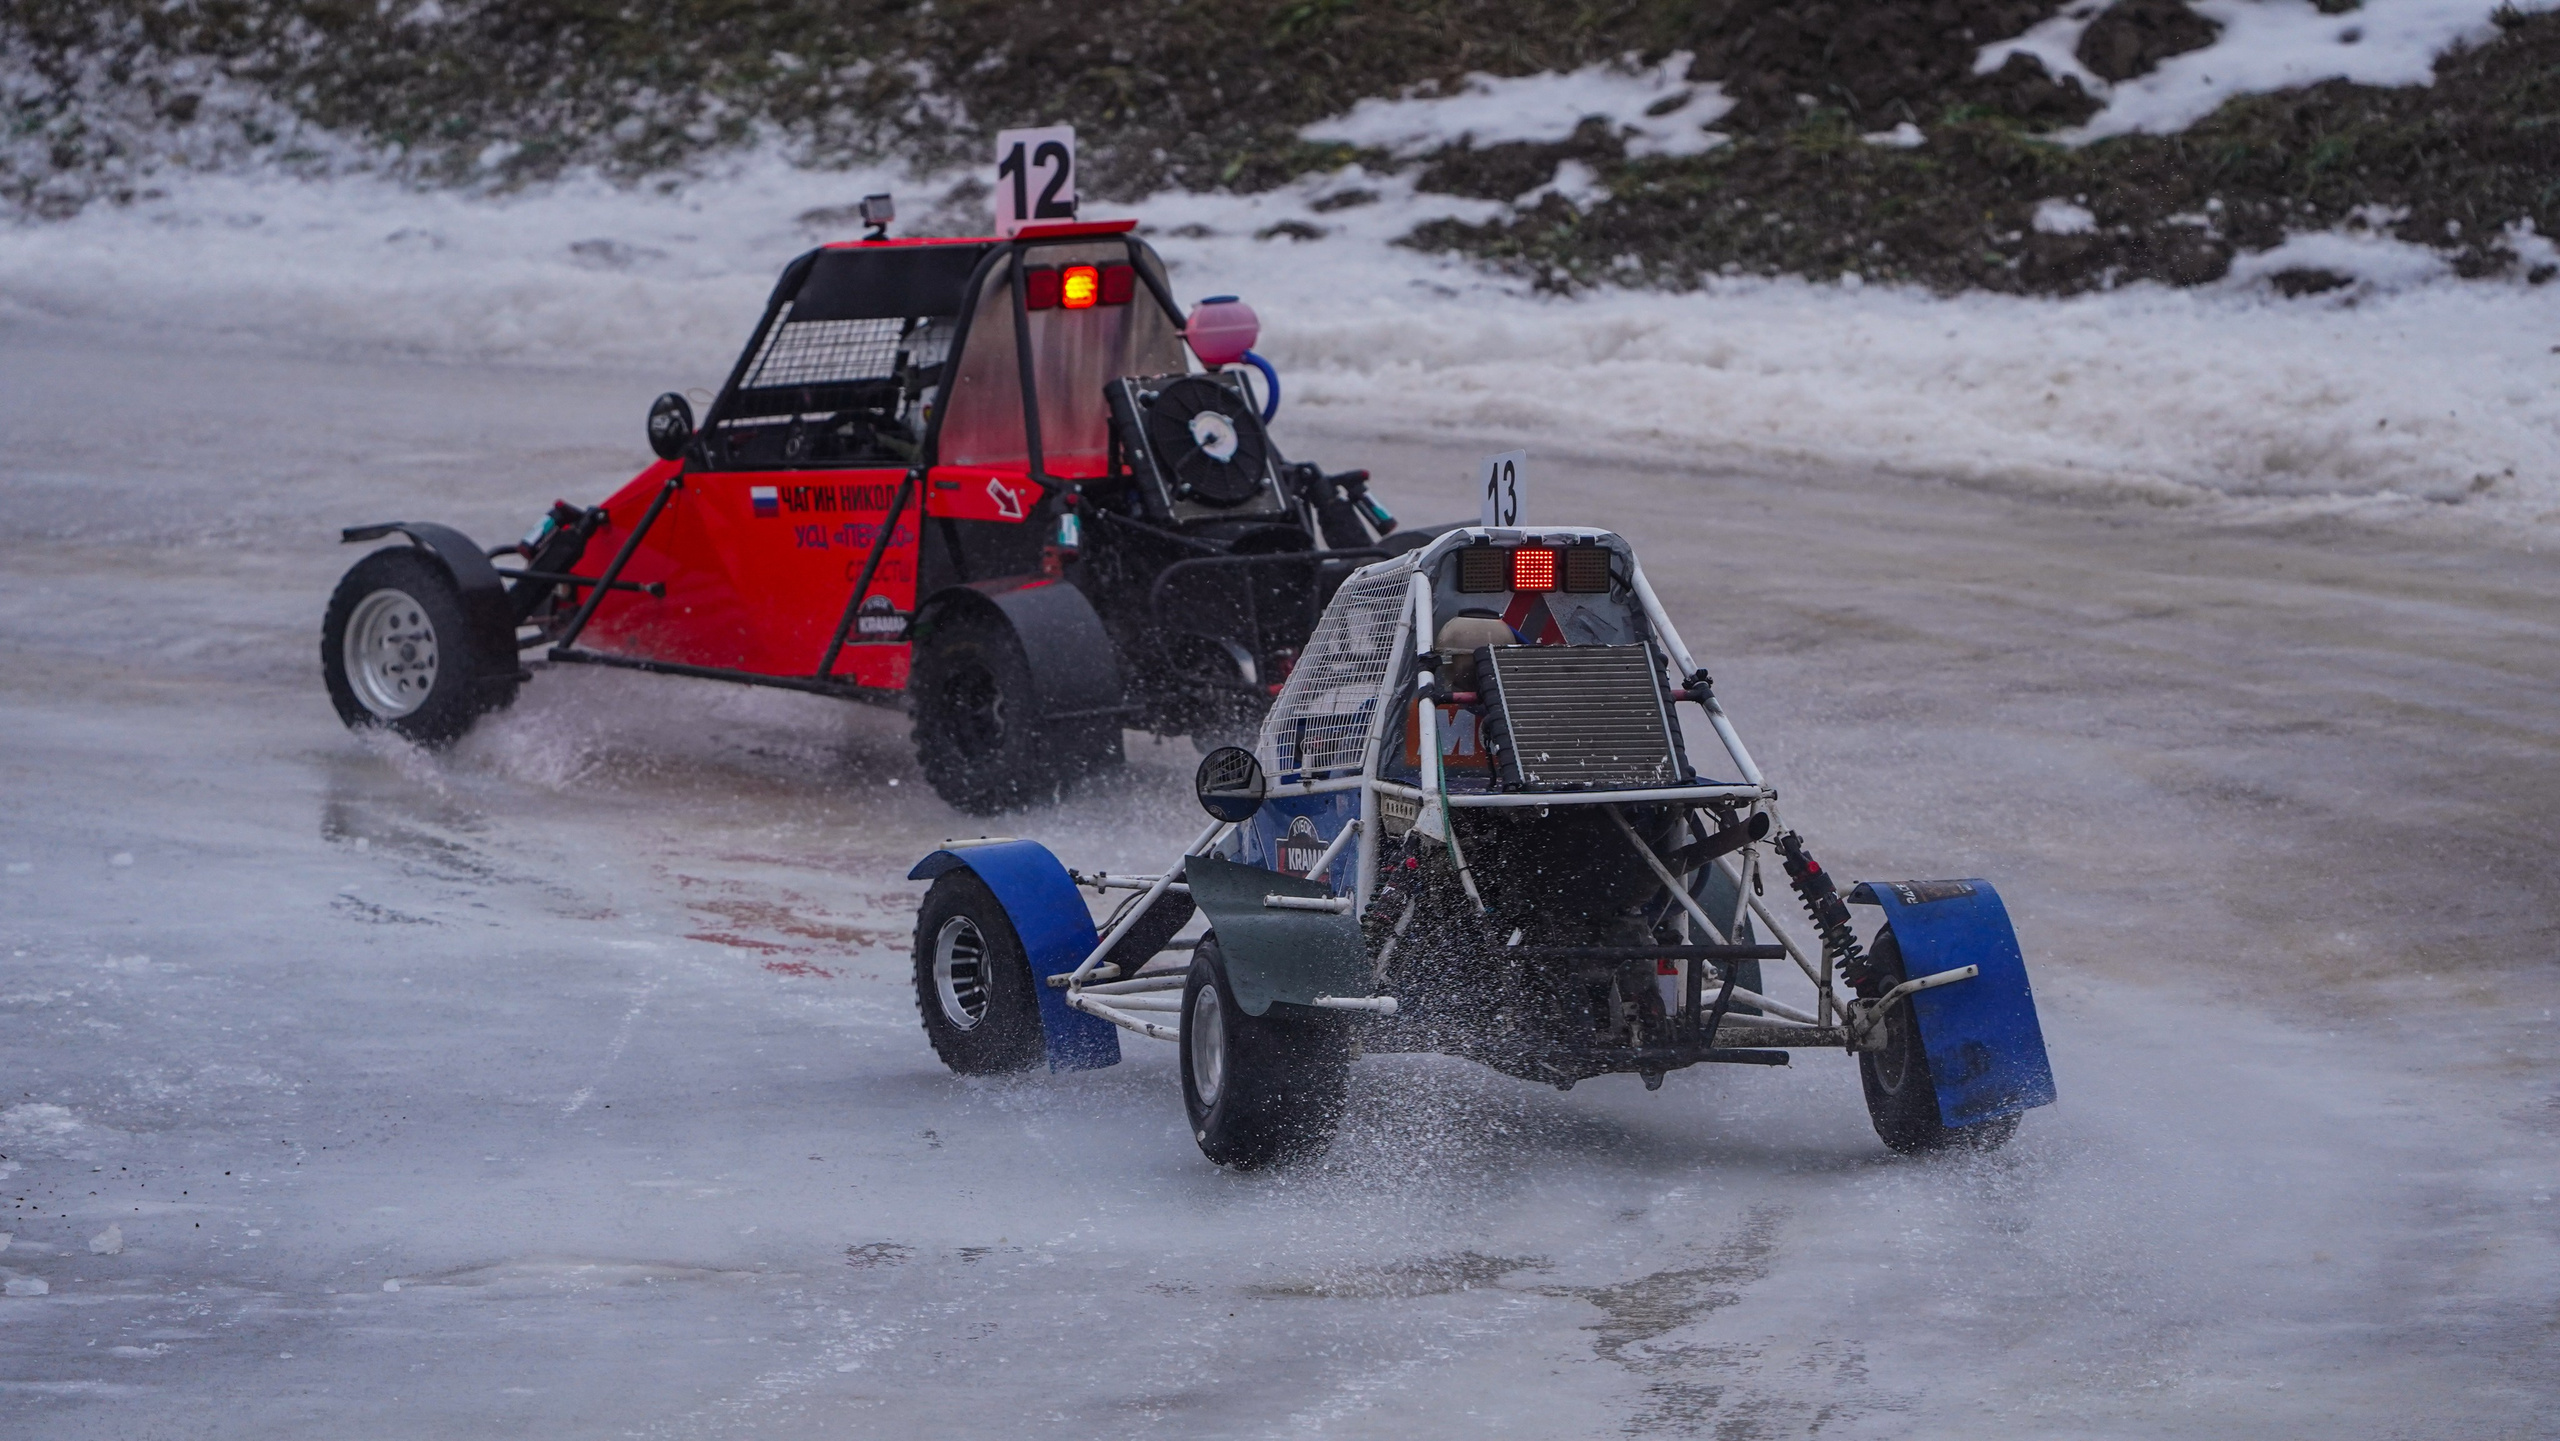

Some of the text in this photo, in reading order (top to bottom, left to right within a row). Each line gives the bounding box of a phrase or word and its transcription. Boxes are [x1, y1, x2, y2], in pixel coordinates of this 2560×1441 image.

[1000, 141, 1073, 219] 12
[781, 485, 837, 512] ЧАГИН
[1488, 460, 1517, 527] 13
